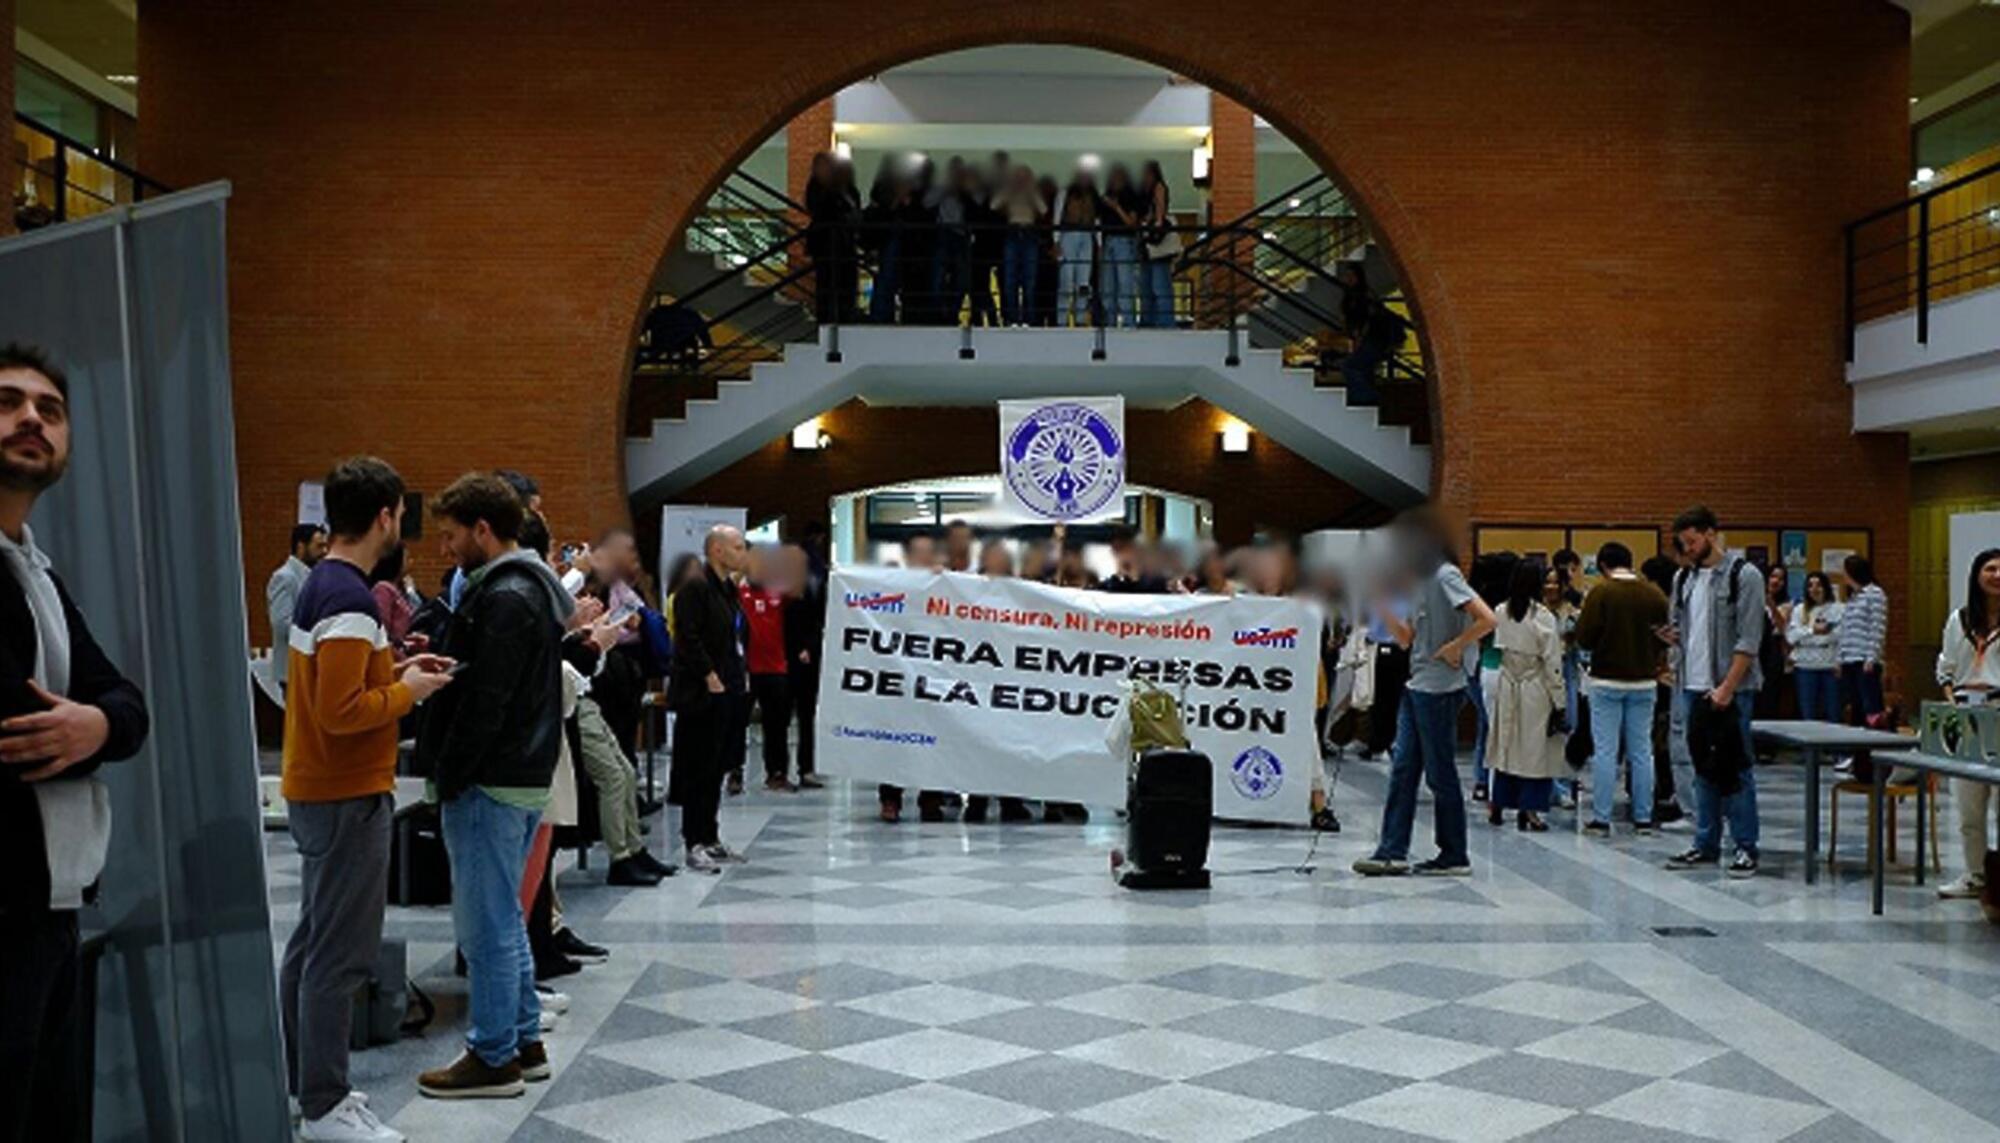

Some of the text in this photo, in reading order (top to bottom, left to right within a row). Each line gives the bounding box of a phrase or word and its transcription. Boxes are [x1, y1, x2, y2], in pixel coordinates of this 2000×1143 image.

[926, 597, 1212, 640] Ni censura, Ni represión
[843, 627, 1293, 692] FUERA EMPRESAS
[841, 668, 1286, 734] DE LA EDUCIÓN
